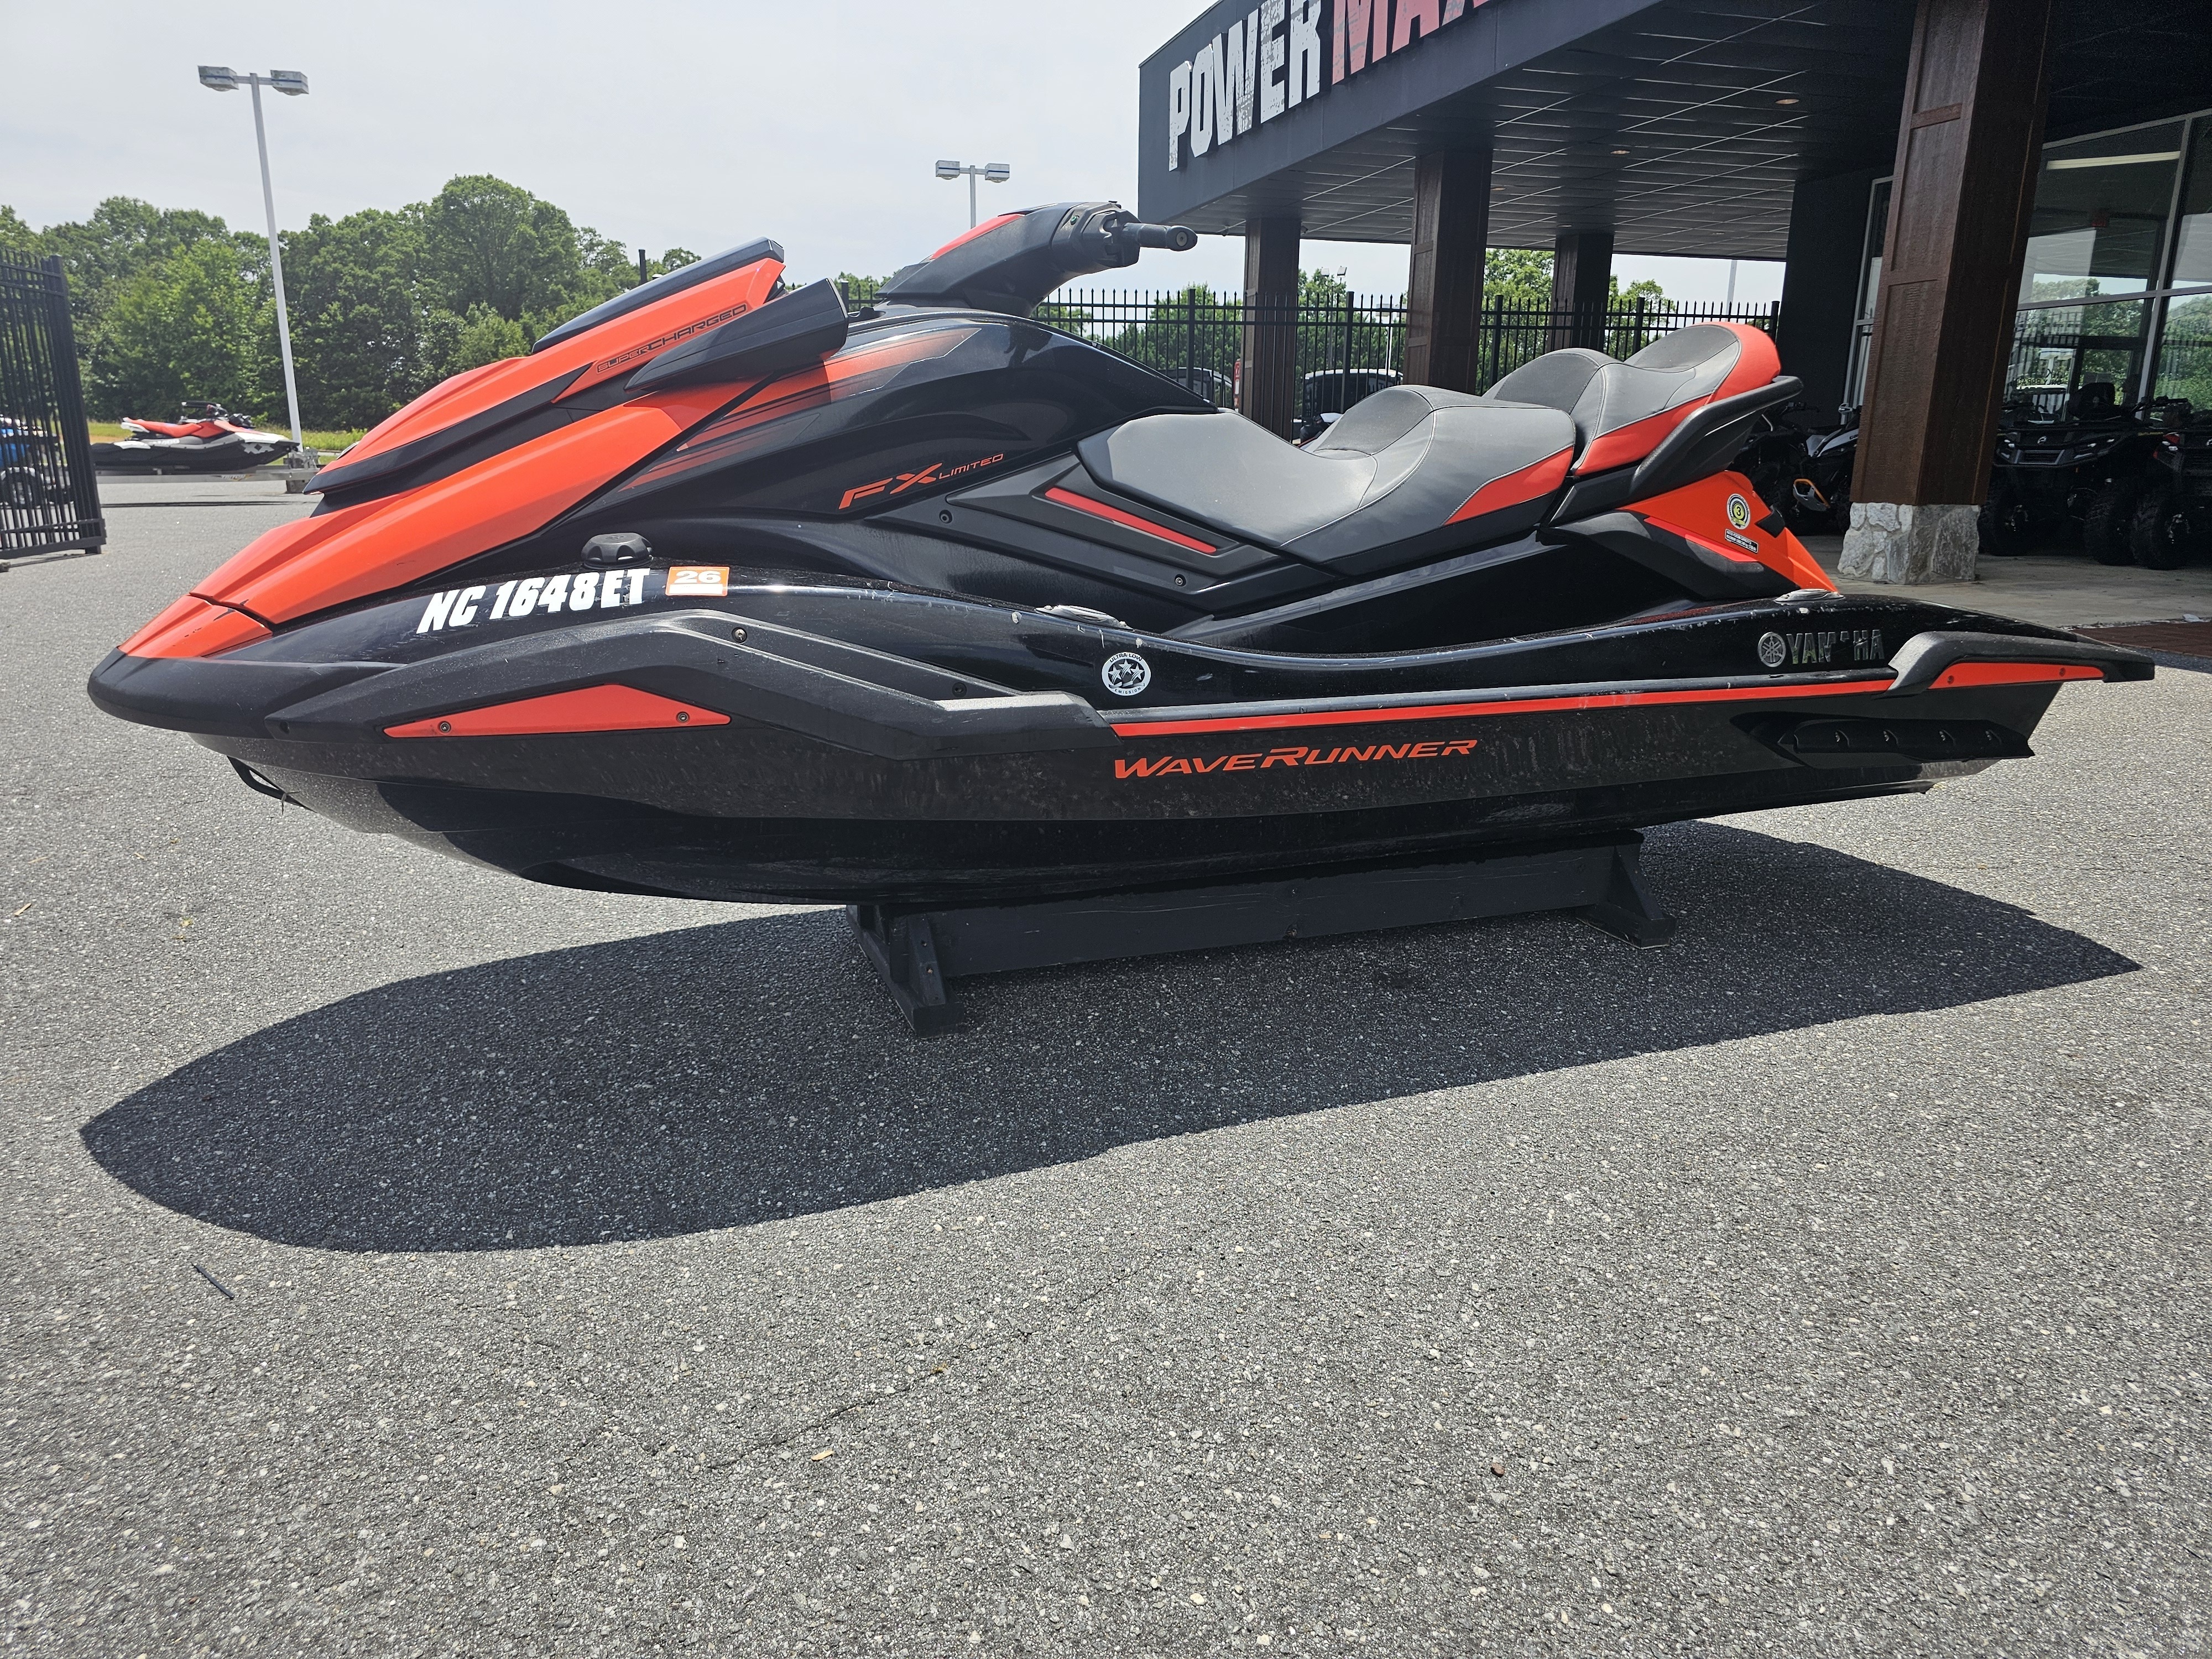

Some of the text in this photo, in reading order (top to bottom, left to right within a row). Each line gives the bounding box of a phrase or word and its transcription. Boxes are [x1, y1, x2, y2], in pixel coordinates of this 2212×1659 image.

[1169, 0, 1321, 171] POWER
[597, 304, 747, 373] SUPERCHARGED
[839, 453, 1004, 509] FX LIMITED
[674, 570, 721, 583] 26
[416, 585, 486, 634] NC
[1109, 653, 1144, 663] ULTRA LOW
[1786, 629, 1885, 664] YAMHA
